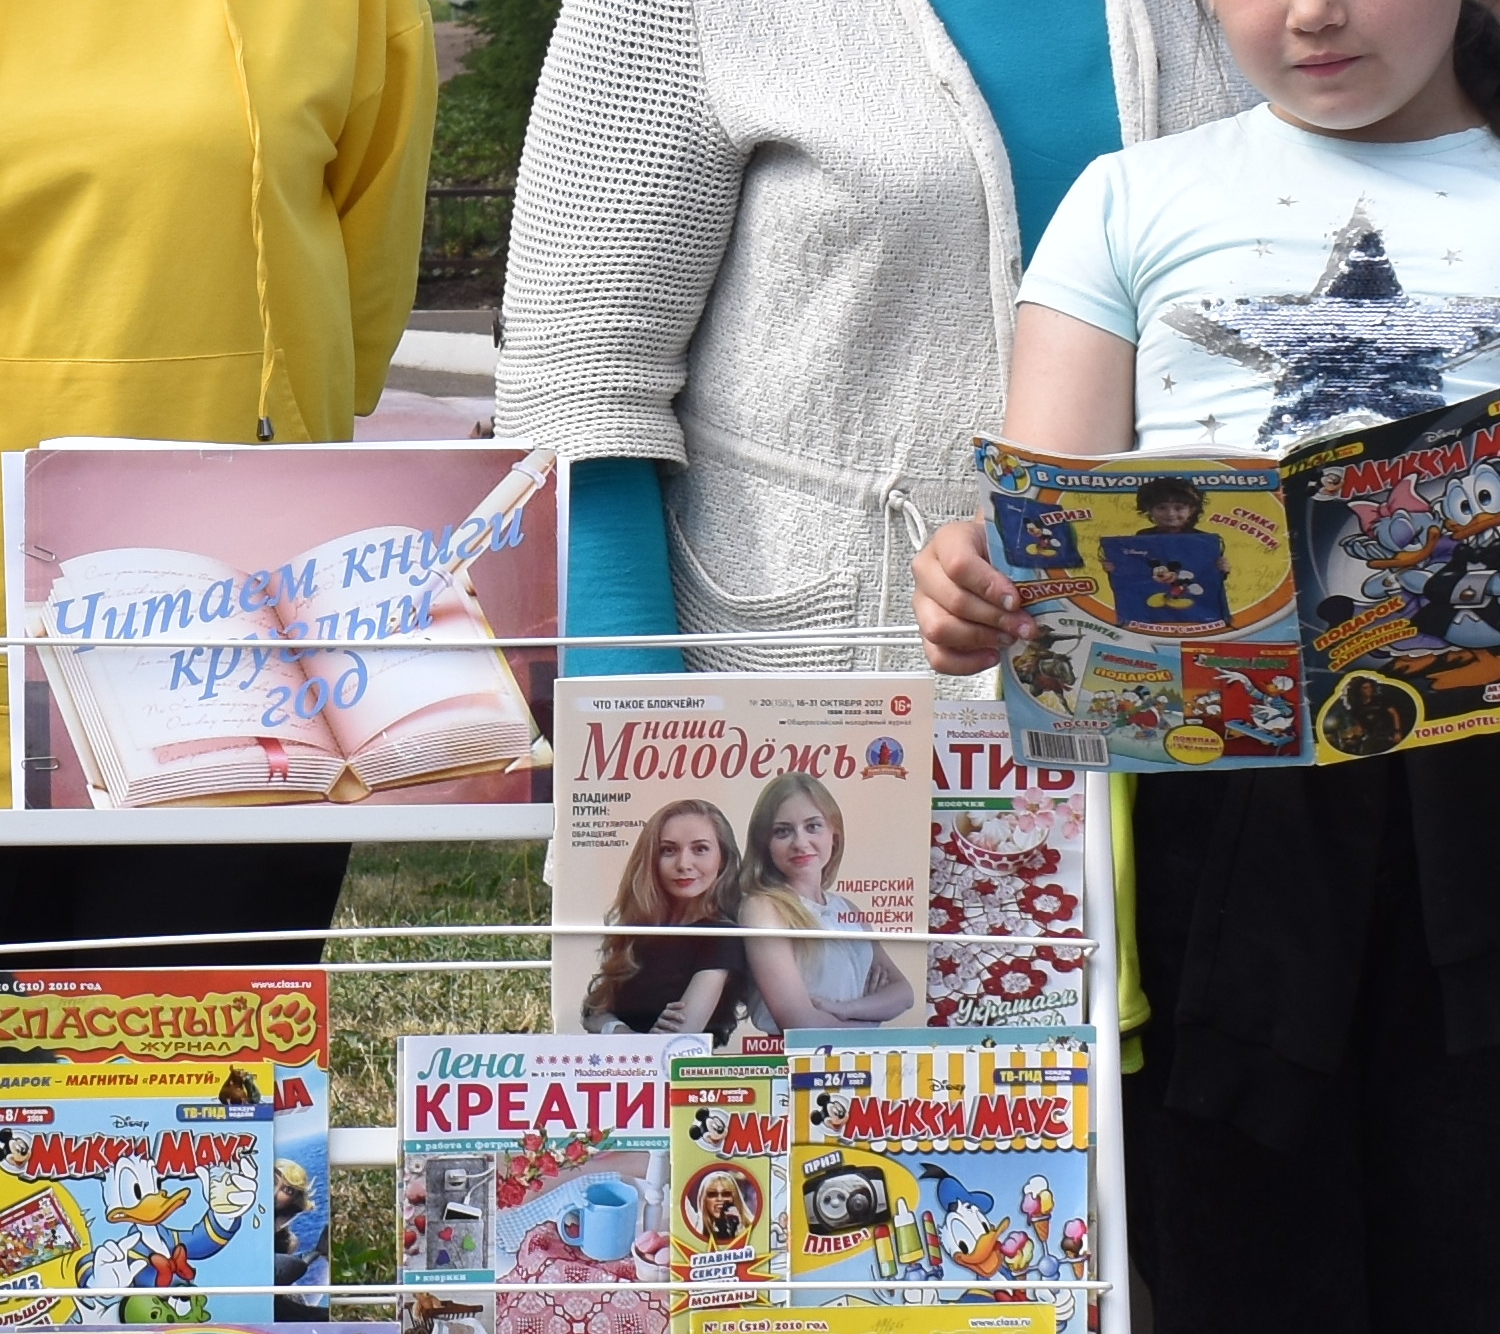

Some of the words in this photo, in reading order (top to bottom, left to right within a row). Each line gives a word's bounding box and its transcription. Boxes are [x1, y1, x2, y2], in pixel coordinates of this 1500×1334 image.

[1040, 508, 1092, 525] ПРИЗ!
[1232, 506, 1277, 532] СУМКА
[53, 556, 319, 656] Читаем
[341, 505, 527, 589] книги
[1314, 595, 1404, 652] ПОДАРОК
[168, 588, 435, 702] круглый
[1094, 668, 1173, 683] ПОДАРОК!
[260, 650, 370, 728] год
[592, 699, 615, 710] ЧТО
[616, 699, 645, 710] ТАКОЕ
[647, 697, 705, 710] БЛОКЧЕЙН?
[642, 720, 726, 742] наша
[573, 722, 857, 782] Молодёжь
[572, 792, 632, 804] ВЛАДИМИР
[572, 806, 611, 817] ПУТИН:
[572, 830, 618, 838] ОБРАЩЕНИЕ
[836, 876, 915, 894] ЛИДЕРСКИЙ
[870, 895, 914, 909] КУЛАК
[837, 907, 914, 925] МОЛОДЁЖИ
[139, 1041, 232, 1053] ЖУРНАЛ
[417, 1047, 526, 1079] Лена
[66, 1074, 138, 1086] МАГНИТЫ
[142, 1070, 221, 1085] «РАТАТУЙ»
[999, 1068, 1043, 1083] ТВ-ГИД
[183, 1107, 226, 1120] ТВ-ГИД
[842, 1095, 967, 1141] МИККИ
[971, 1094, 1072, 1140] МАУС
[803, 1150, 842, 1175] ПРИЗ!
[803, 1229, 869, 1255] ПЛЕЕР!
[692, 1249, 753, 1265] ГЛАВНЫЙ
[692, 1266, 735, 1278] СЕКРЕТ
[692, 1291, 755, 1306] МОНТАНЫ
[721, 1322, 735, 1332] 18
[739, 1320, 771, 1333] (518)
[775, 1322, 803, 1332] 2010
[806, 1323, 828, 1332] год
